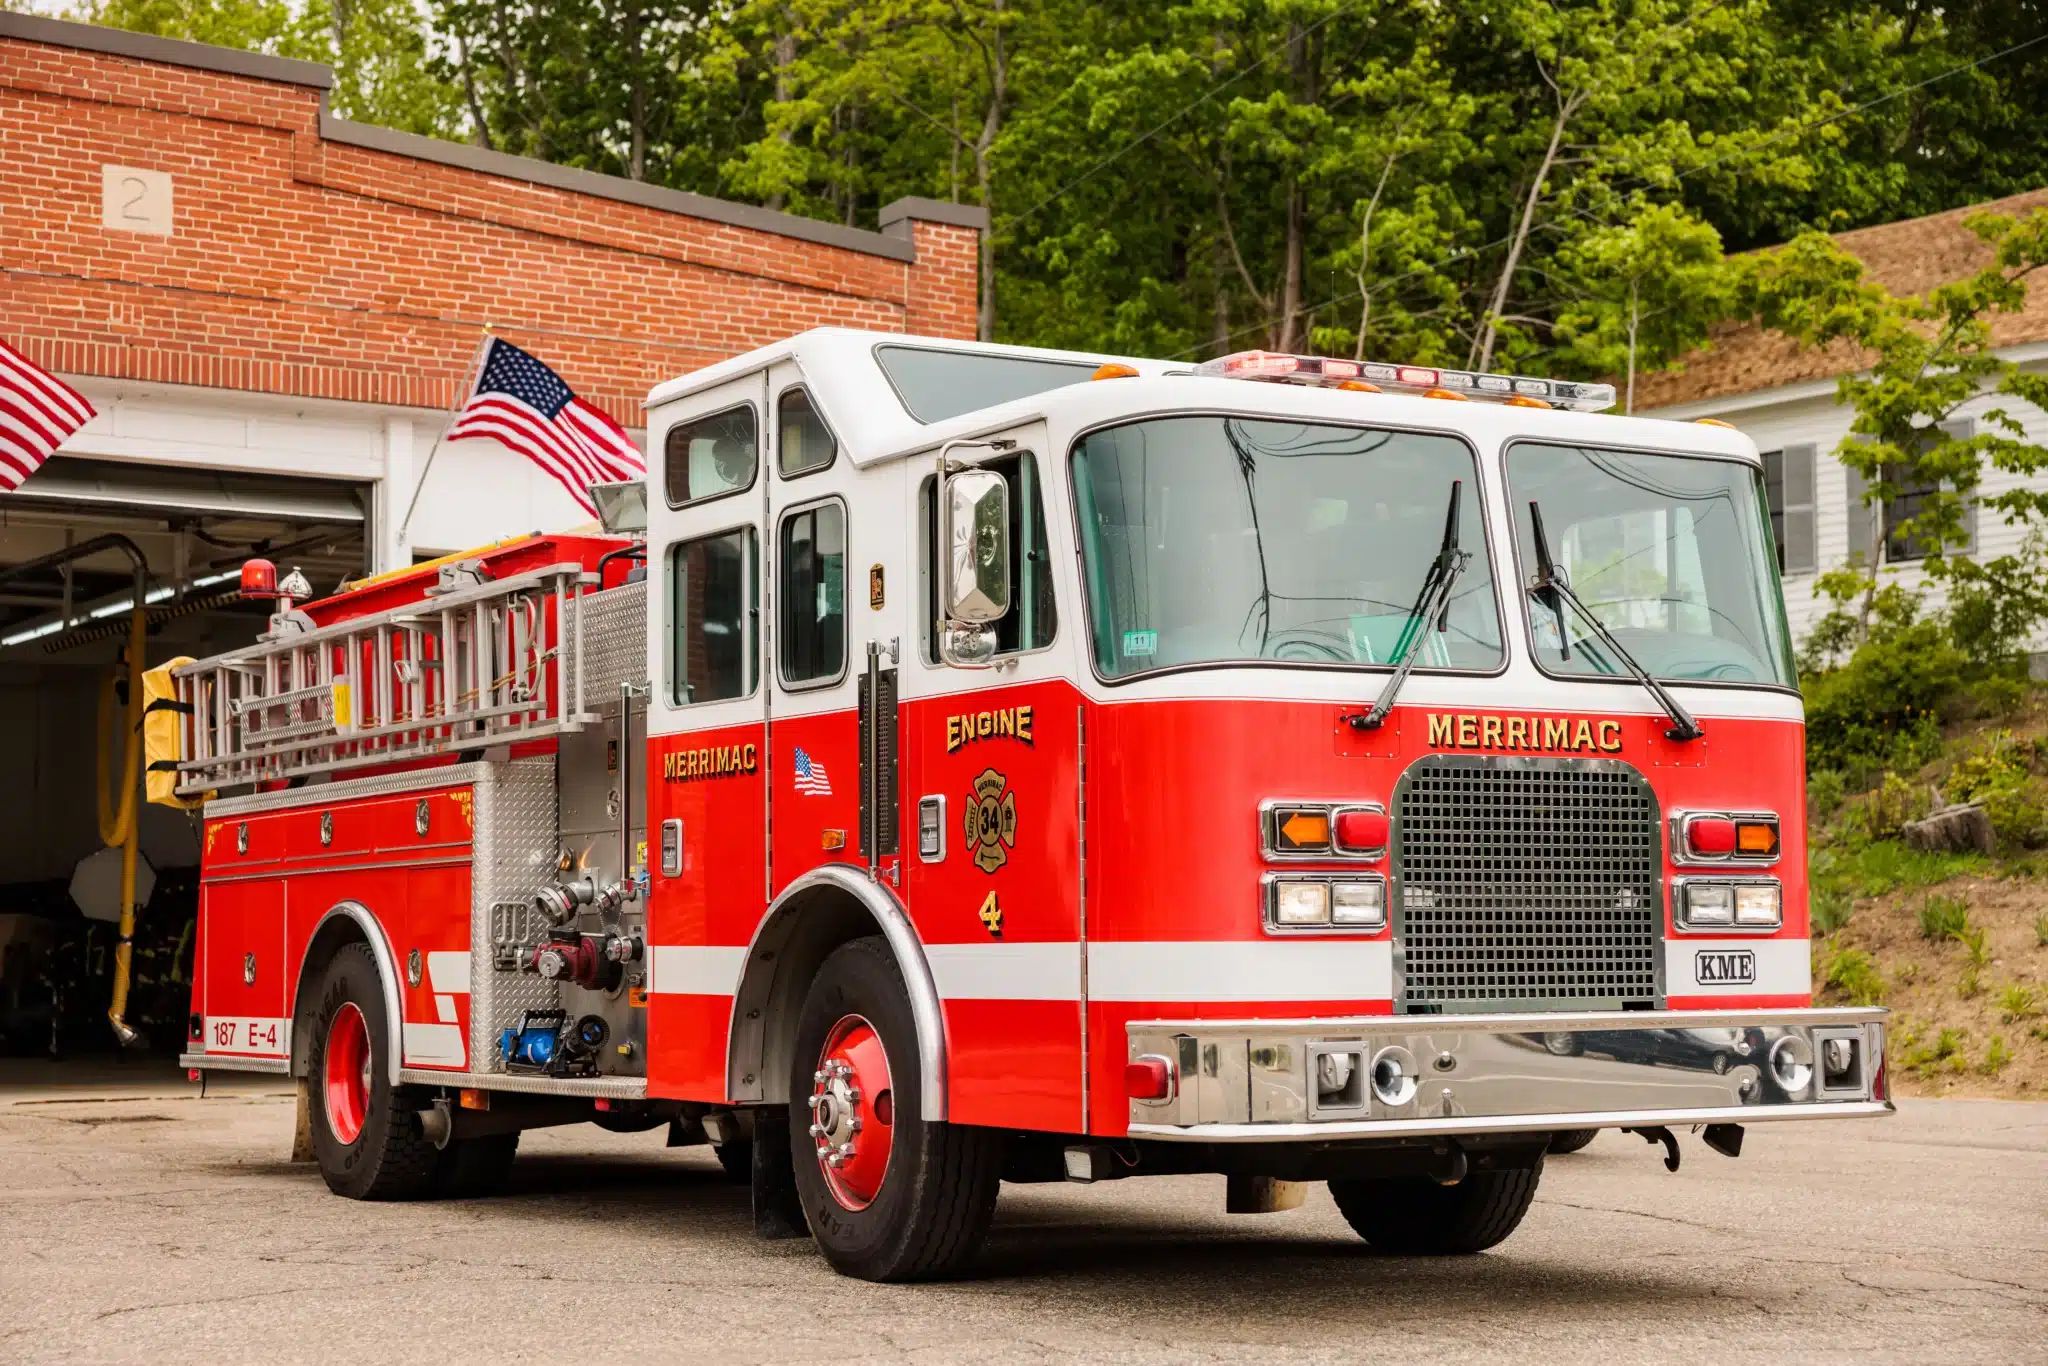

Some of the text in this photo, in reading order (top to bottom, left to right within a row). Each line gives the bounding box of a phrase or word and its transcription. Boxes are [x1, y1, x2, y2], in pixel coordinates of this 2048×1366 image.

[121, 176, 151, 221] 2
[946, 705, 1034, 752] ENGINE
[1427, 713, 1622, 751] MERRIMAC
[664, 743, 758, 783] MERRIMAC
[980, 806, 999, 836] 34
[978, 890, 1003, 936] 4
[1699, 955, 1752, 980] KME
[214, 1022, 277, 1047] 187 E-4
